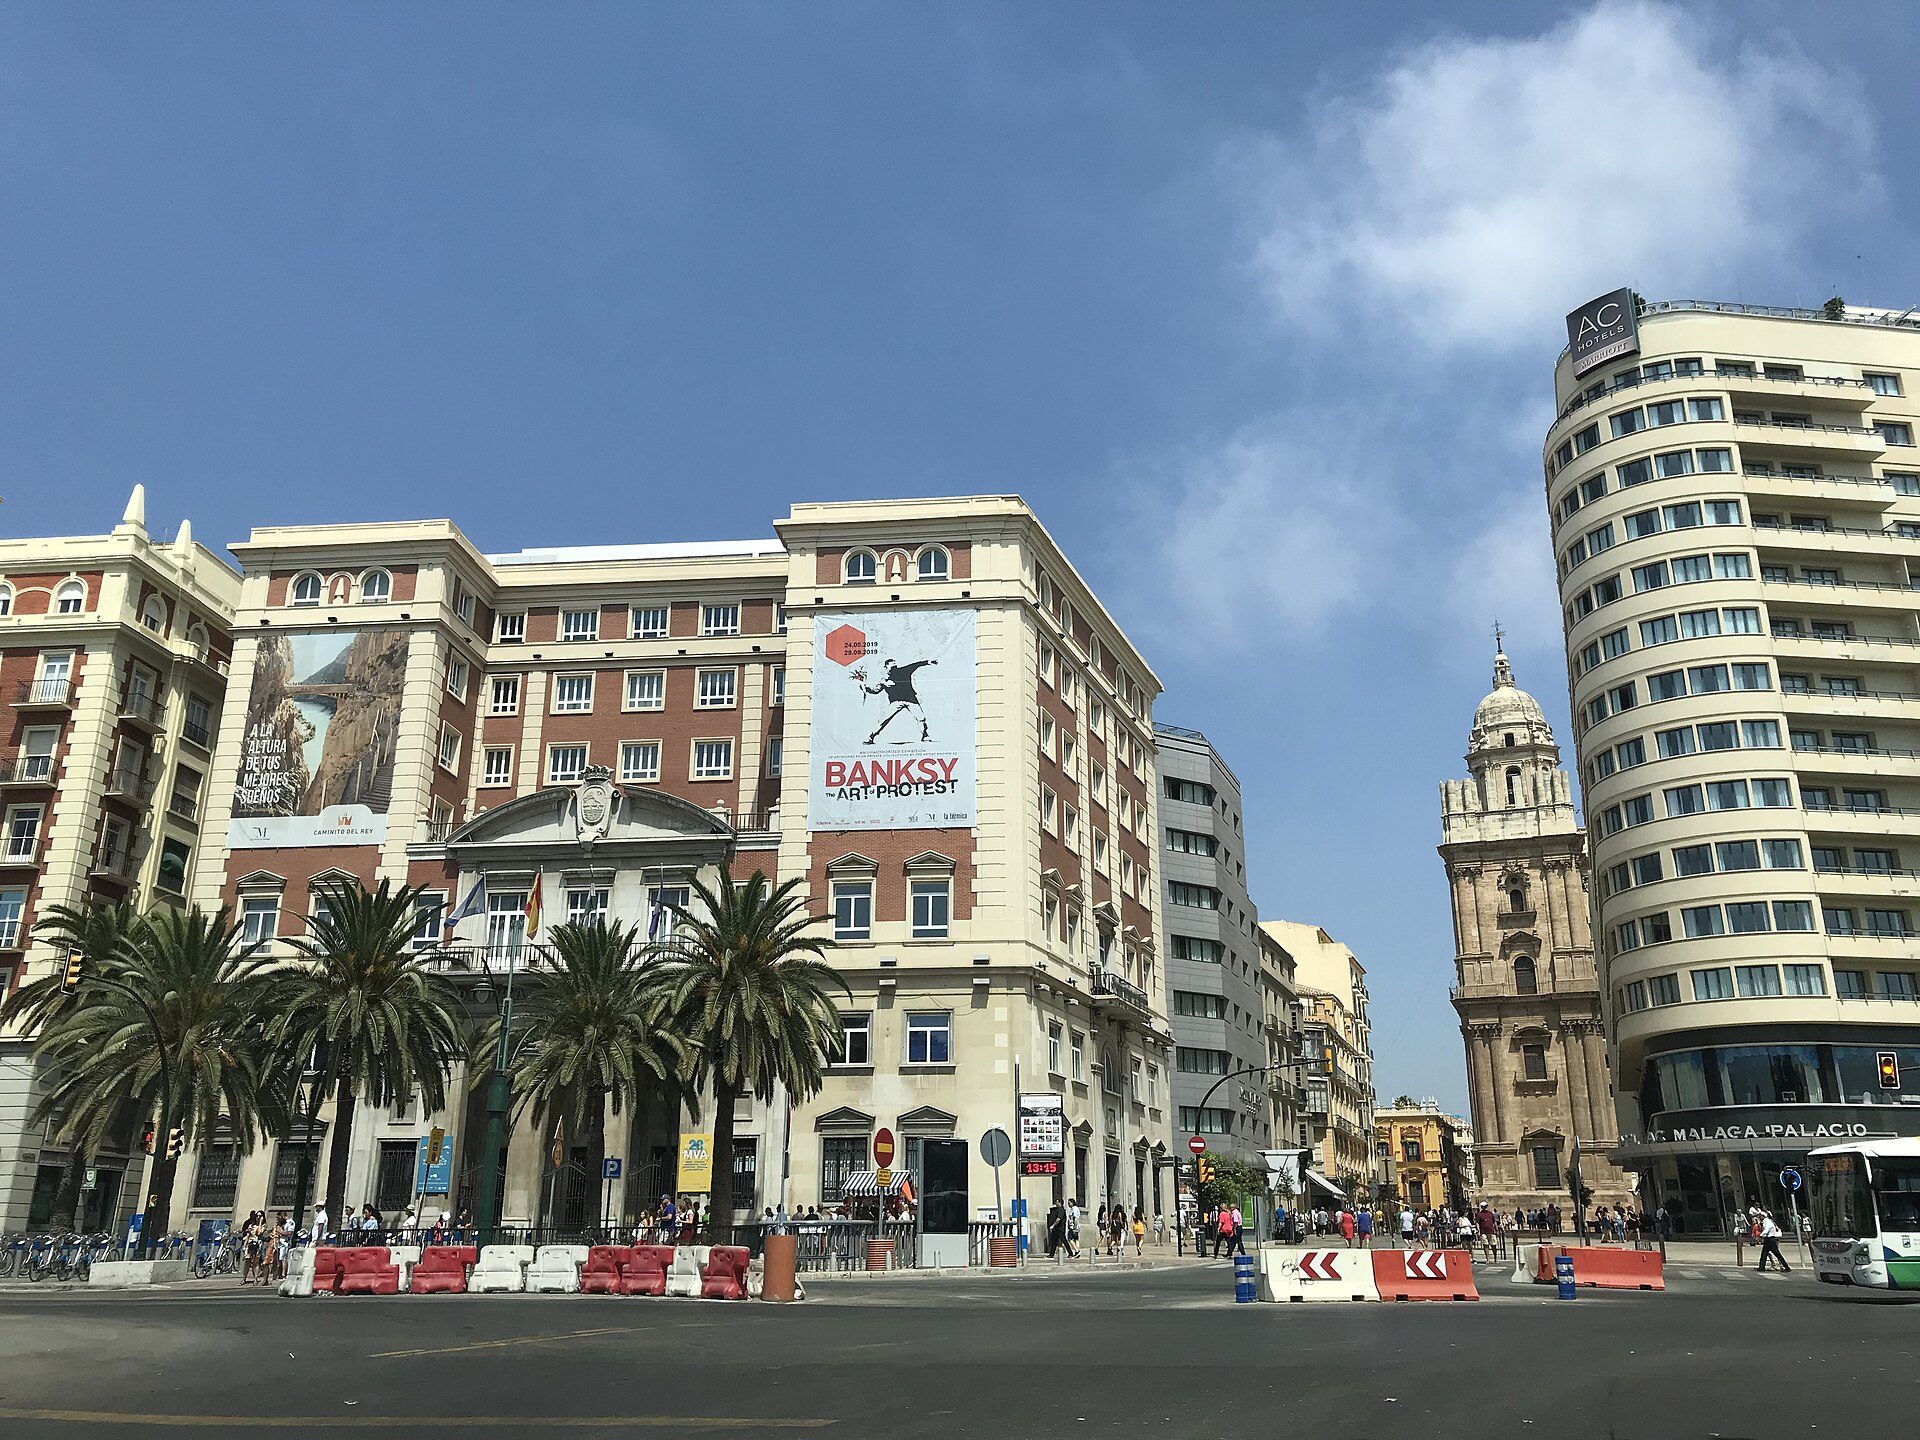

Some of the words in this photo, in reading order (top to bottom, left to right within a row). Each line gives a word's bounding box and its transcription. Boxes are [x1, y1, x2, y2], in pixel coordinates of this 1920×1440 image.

[1577, 303, 1621, 341] AC
[1577, 325, 1625, 352] HOTELS
[1580, 342, 1628, 369] MARRIOTT
[250, 723, 258, 737] A
[260, 723, 273, 737] LA
[248, 739, 287, 754] ALTURA
[245, 756, 260, 771] DE
[262, 755, 281, 770] TUS
[243, 772, 290, 788] MEJORES
[825, 757, 958, 787] BANKSY
[837, 785, 872, 801] ART
[877, 779, 958, 798] PROTEST
[1770, 1122, 1868, 1138] PALACIO
[682, 1149, 708, 1160] MVA
[606, 1160, 618, 1177] P
[1026, 1162, 1057, 1173] 13:15
